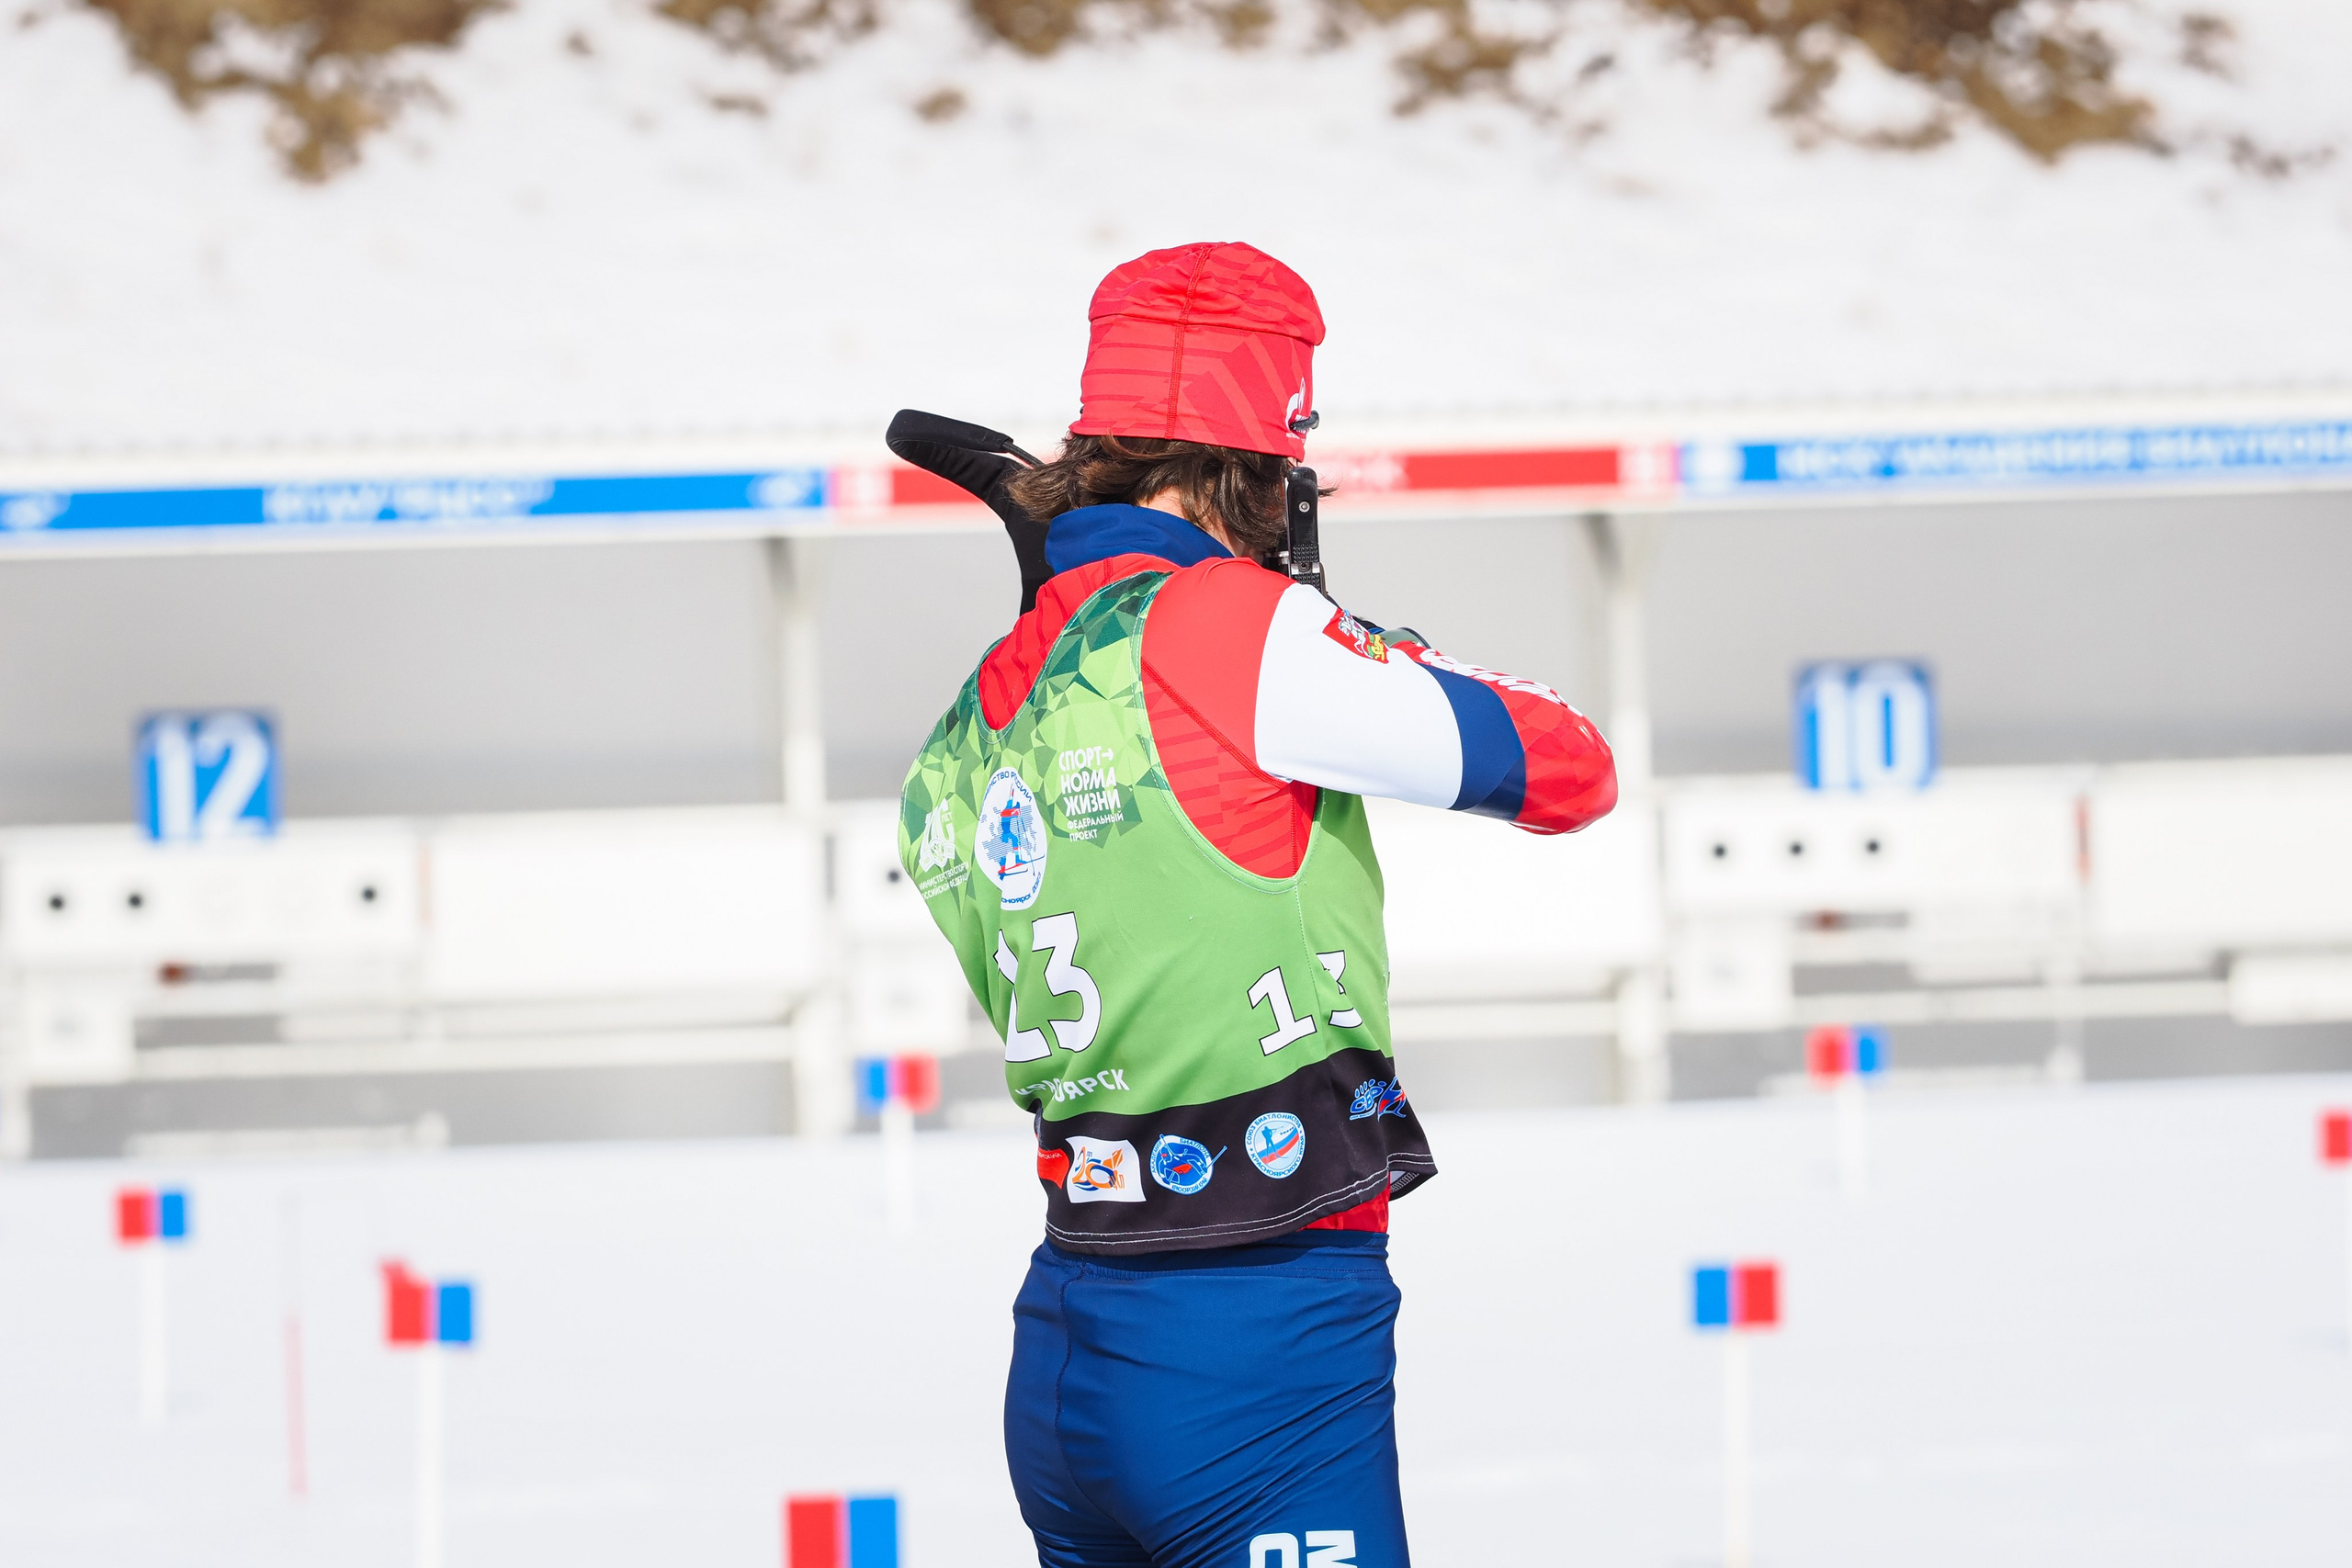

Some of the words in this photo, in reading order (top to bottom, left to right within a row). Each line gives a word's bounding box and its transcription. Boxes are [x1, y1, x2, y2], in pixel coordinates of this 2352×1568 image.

[1799, 663, 1931, 792] 10
[1058, 746, 1102, 771] СПОРТ
[142, 709, 272, 838] 12
[1060, 767, 1116, 795] НОРМА
[1063, 789, 1121, 817] ЖИЗНИ
[1068, 810, 1124, 829] ФЕДЕРАЛЬНЫЙ
[1069, 829, 1097, 842] ПРОЕКТ
